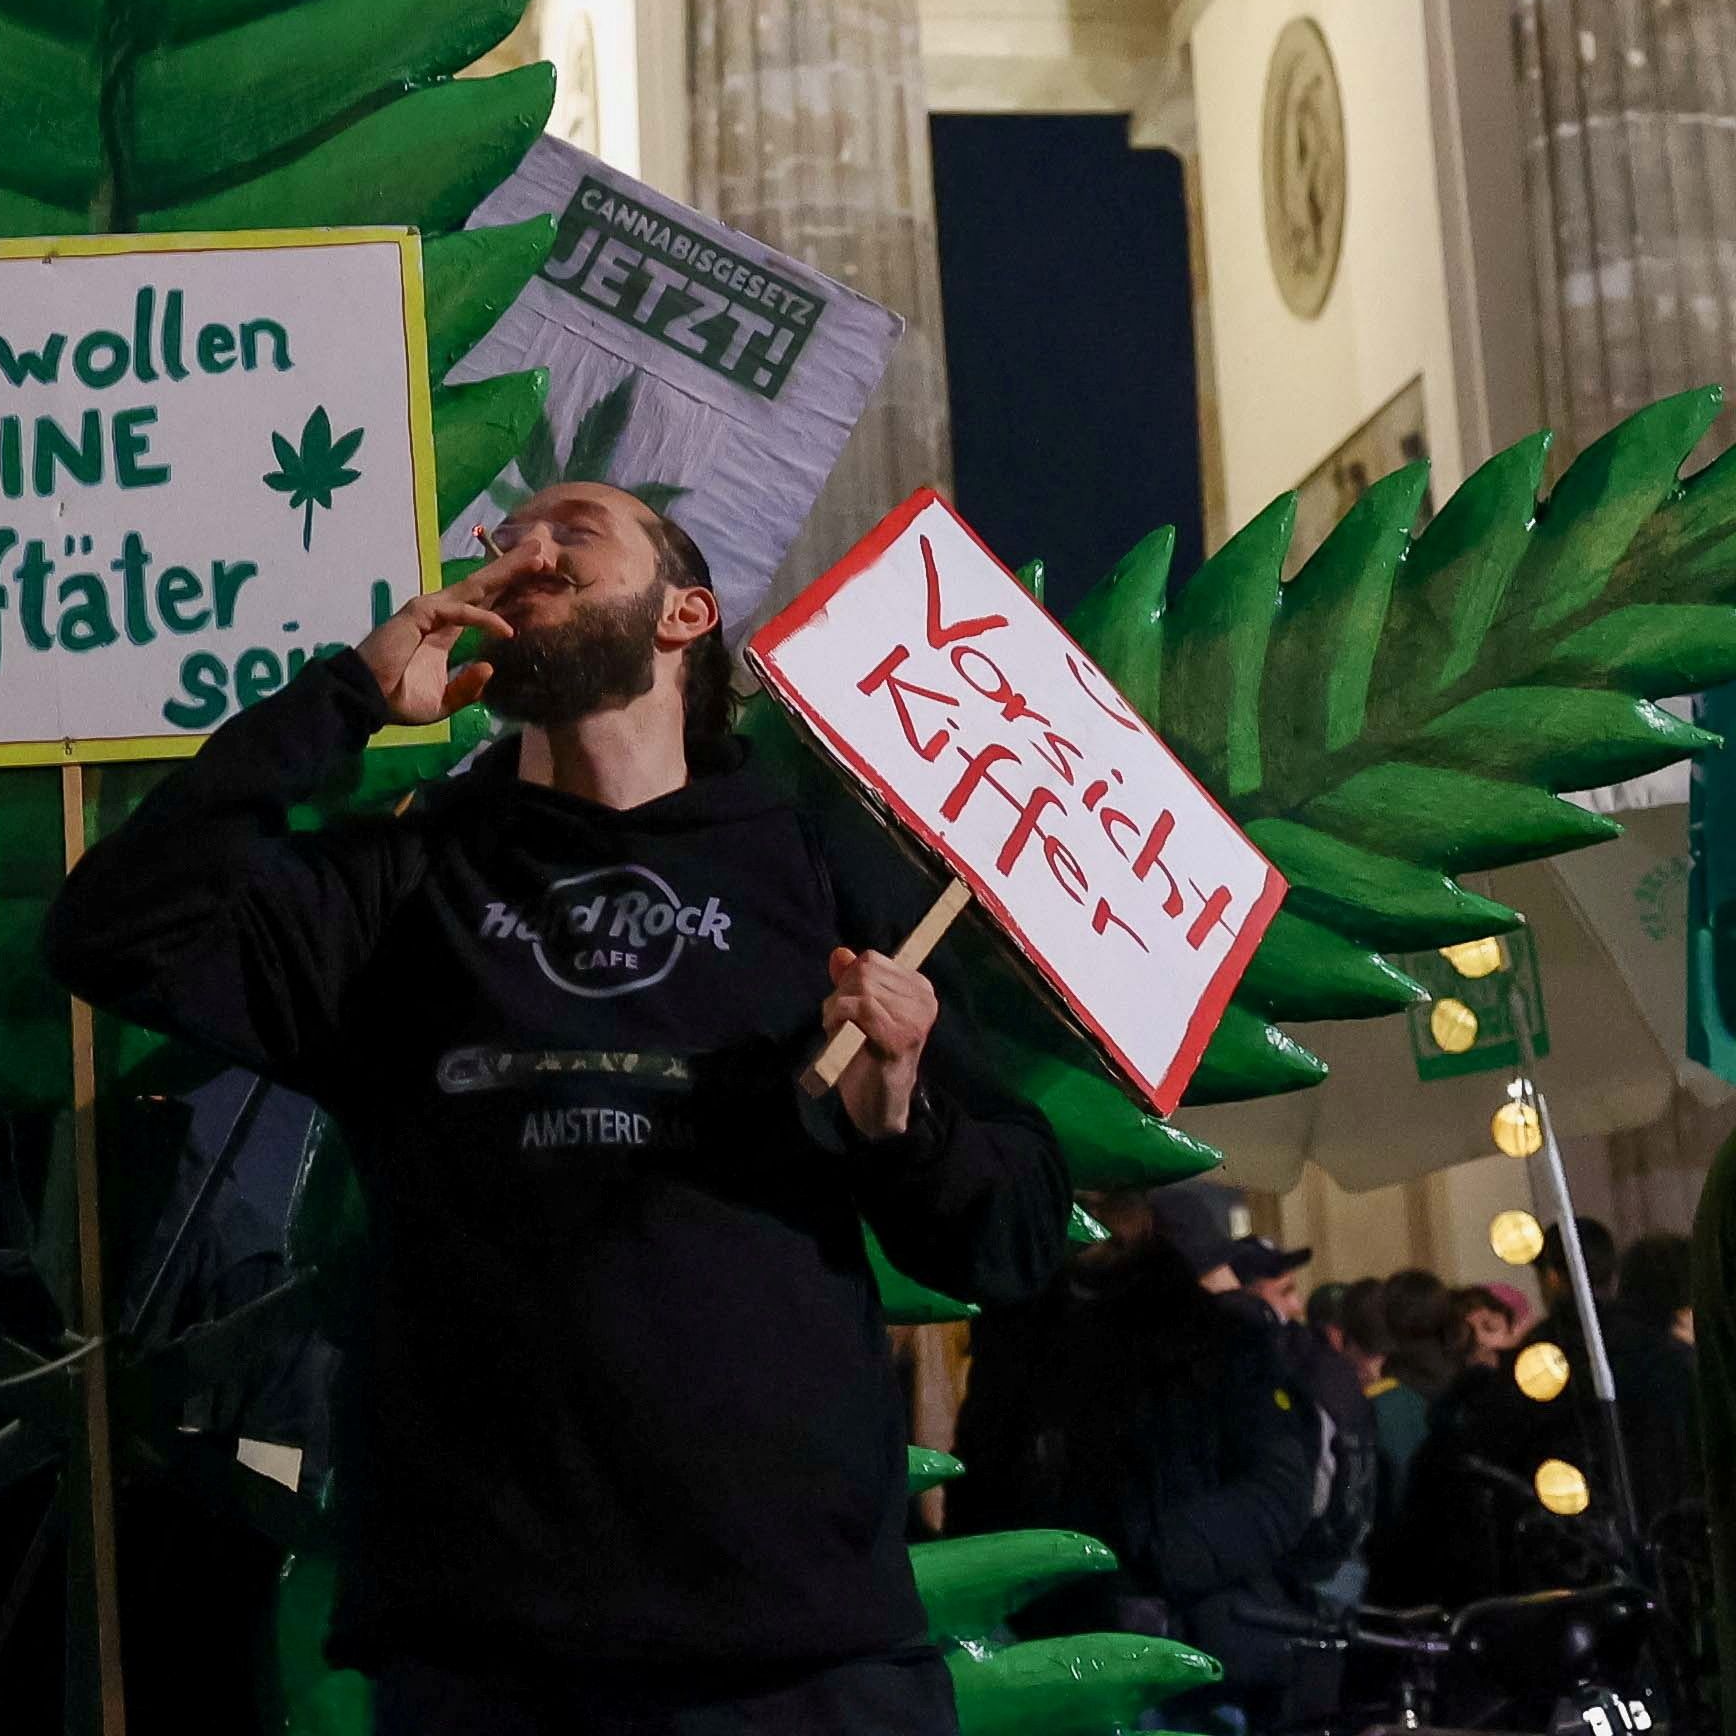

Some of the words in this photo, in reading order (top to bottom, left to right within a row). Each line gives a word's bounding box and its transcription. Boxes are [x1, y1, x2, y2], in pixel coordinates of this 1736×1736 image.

[543, 227, 795, 387] JETZT!
[581, 188, 815, 325] CANNABISGESETZ
[857, 644, 1150, 954] Kiffer
[920, 534, 1238, 951] Vorsicht
[574, 949, 640, 970] CAFE
[609, 890, 732, 951] Rock
